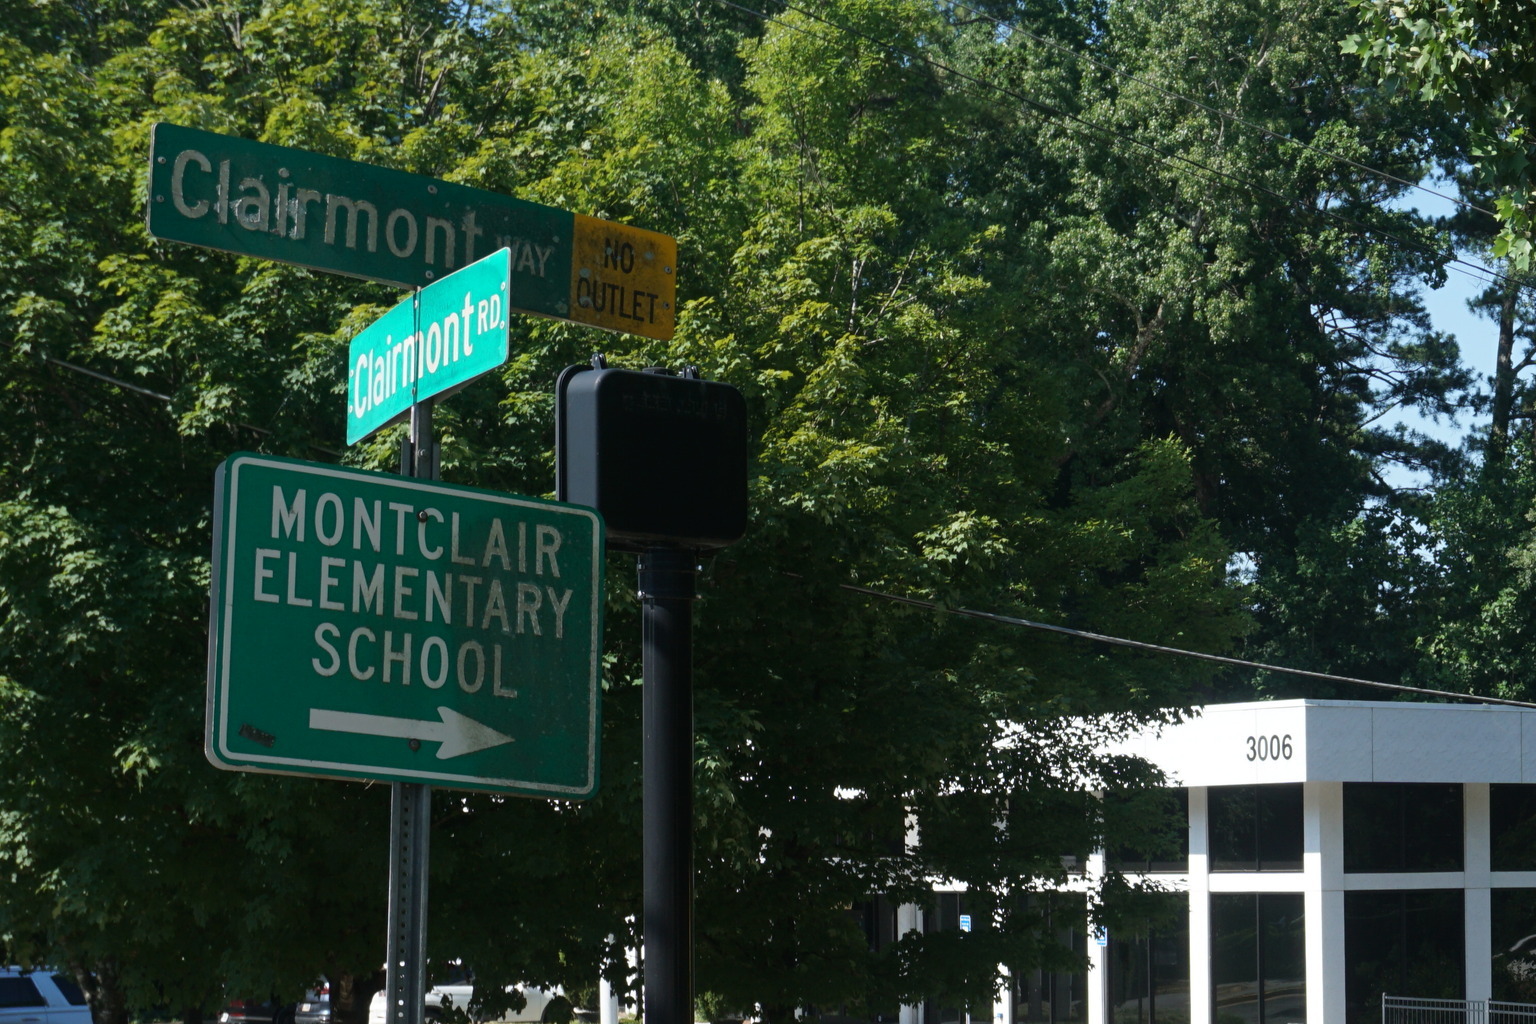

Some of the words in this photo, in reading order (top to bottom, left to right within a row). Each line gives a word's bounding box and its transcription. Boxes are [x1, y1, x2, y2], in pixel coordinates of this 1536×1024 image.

[171, 149, 483, 271] Clairmont
[496, 235, 550, 278] WAY
[604, 237, 635, 274] NO
[577, 277, 659, 324] OUTLET
[354, 294, 473, 419] Clairmont
[477, 293, 501, 335] RD
[271, 485, 562, 578] MONTCLAIR
[253, 548, 574, 639] ELEMENTARY
[312, 622, 518, 698] SCHOOL
[1246, 734, 1293, 762] 3006
